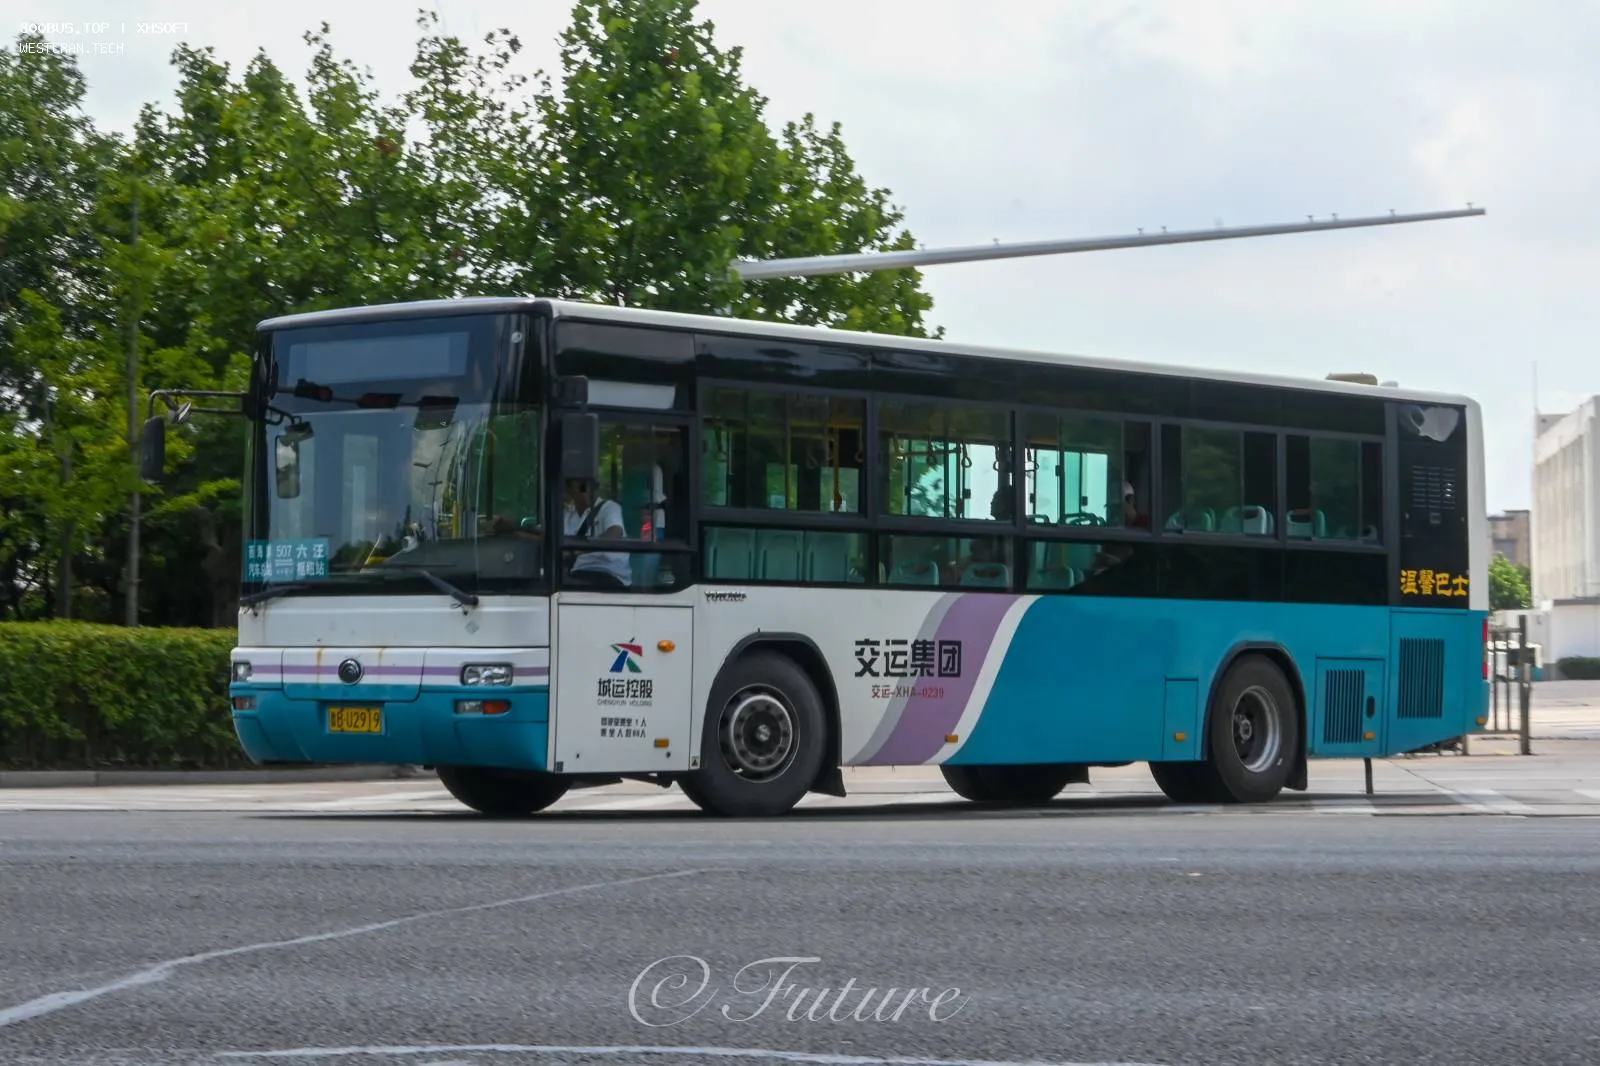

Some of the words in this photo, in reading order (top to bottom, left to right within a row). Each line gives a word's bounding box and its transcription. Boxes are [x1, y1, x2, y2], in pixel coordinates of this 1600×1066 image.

[276, 544, 293, 558] 507
[854, 638, 962, 678] 交运集团
[597, 677, 653, 699] 城运控股
